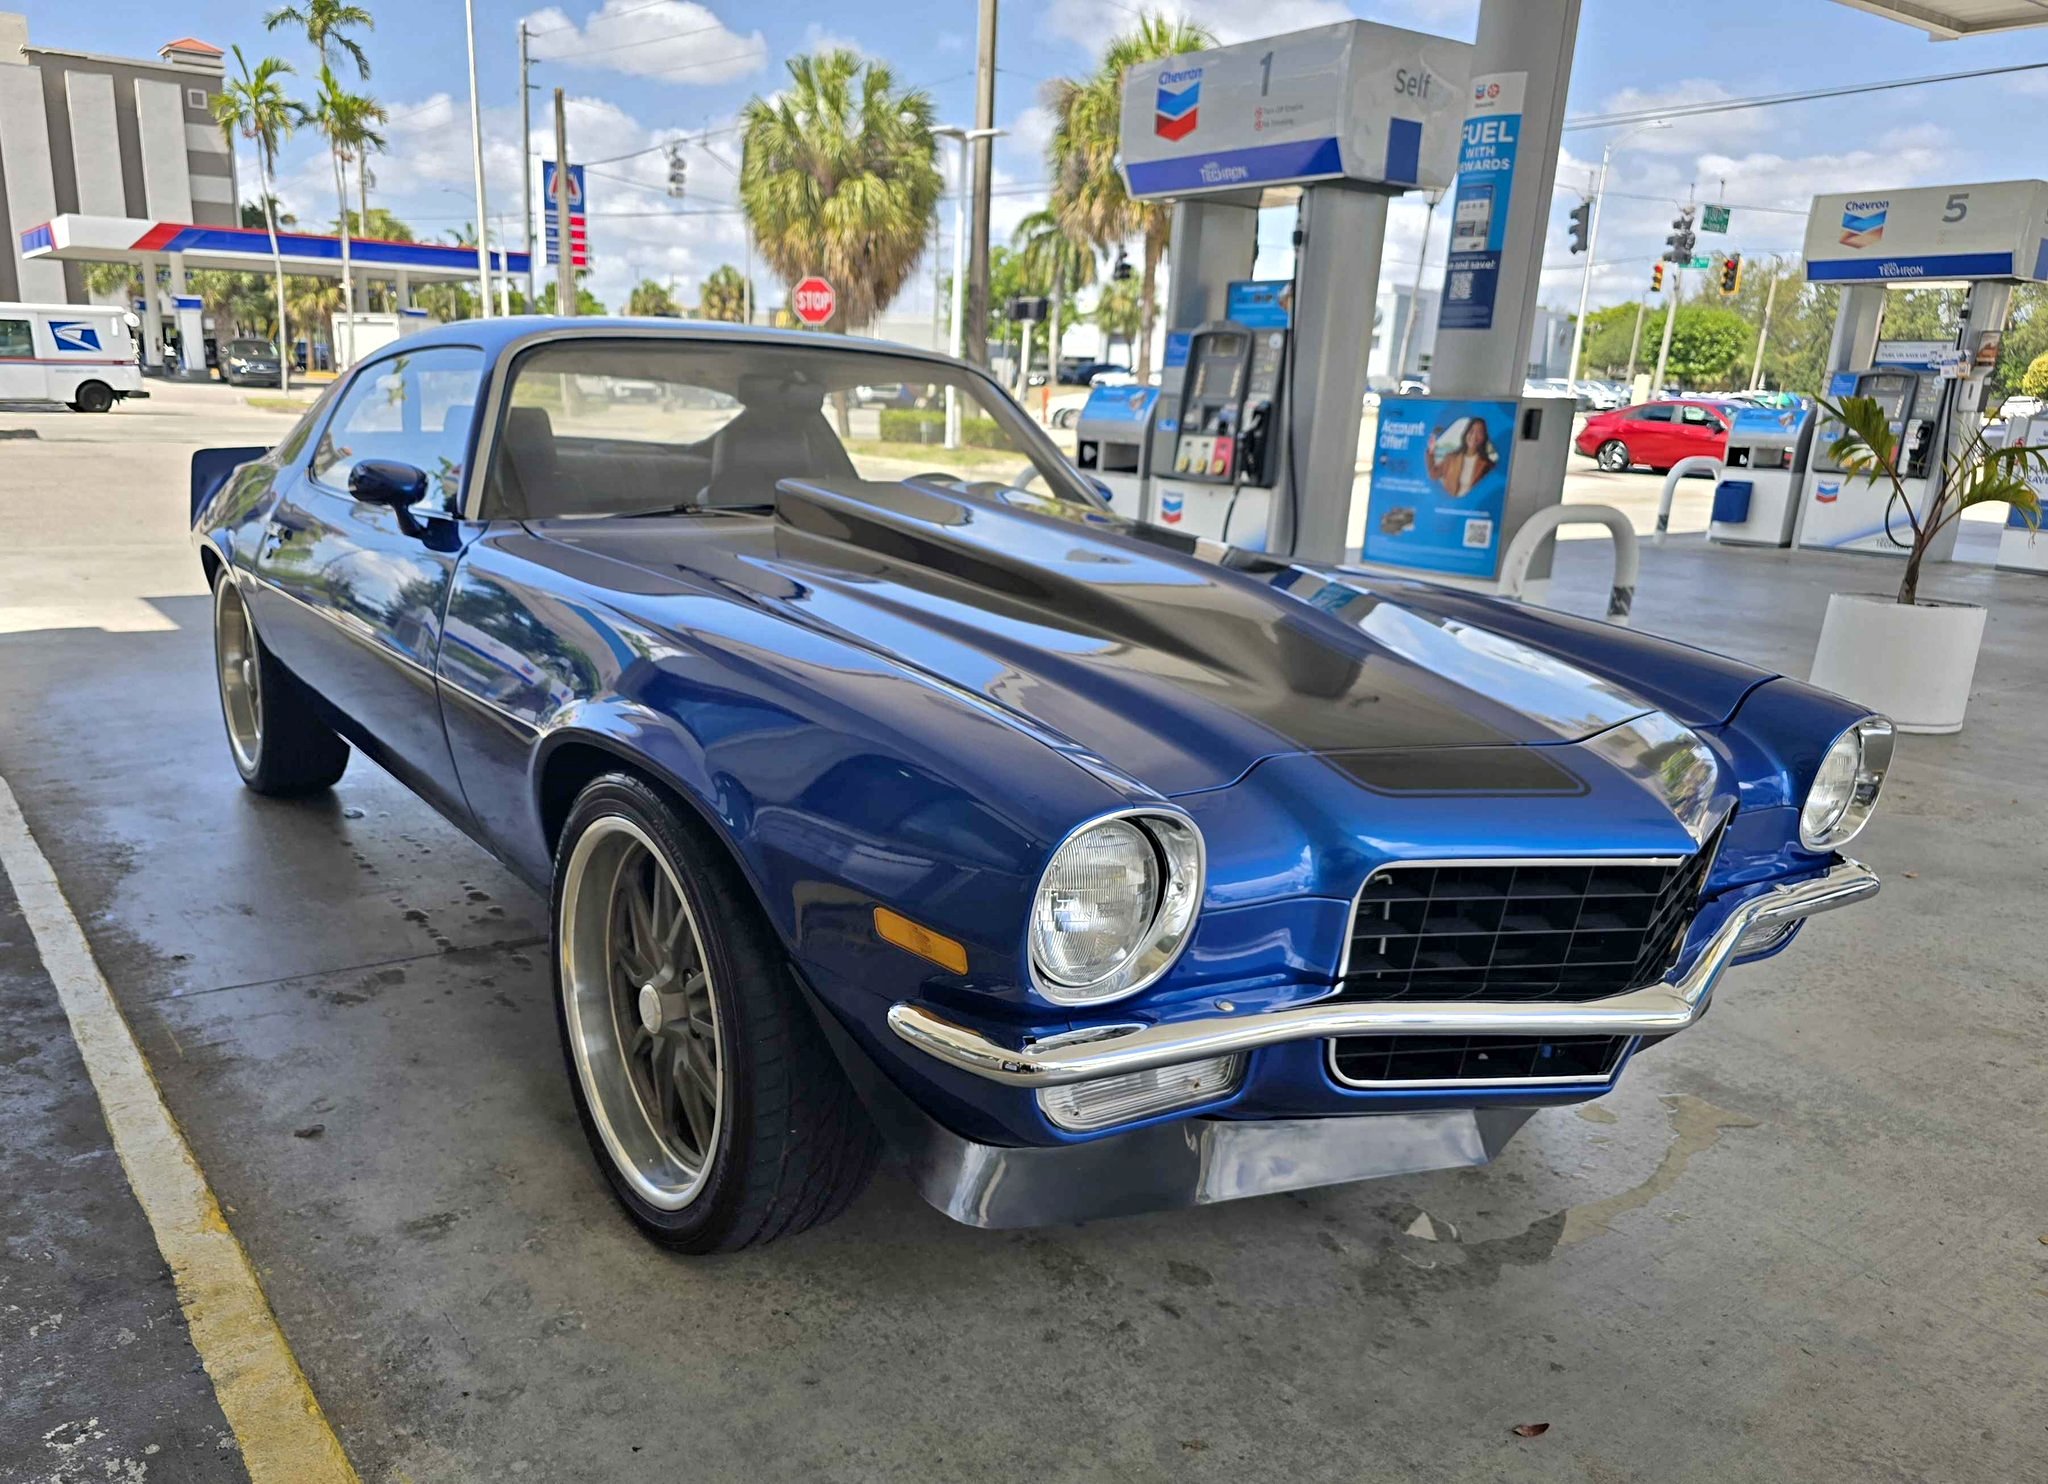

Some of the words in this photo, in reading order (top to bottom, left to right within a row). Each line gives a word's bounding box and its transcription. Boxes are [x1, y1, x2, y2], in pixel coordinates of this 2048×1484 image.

[1158, 67, 1203, 85] Chevron
[1260, 51, 1274, 96] 1
[1393, 68, 1432, 98] Self
[1465, 145, 1497, 159] WITH
[1844, 200, 1889, 211] Chevron
[1942, 193, 1969, 223] 5
[796, 291, 832, 311] STOP
